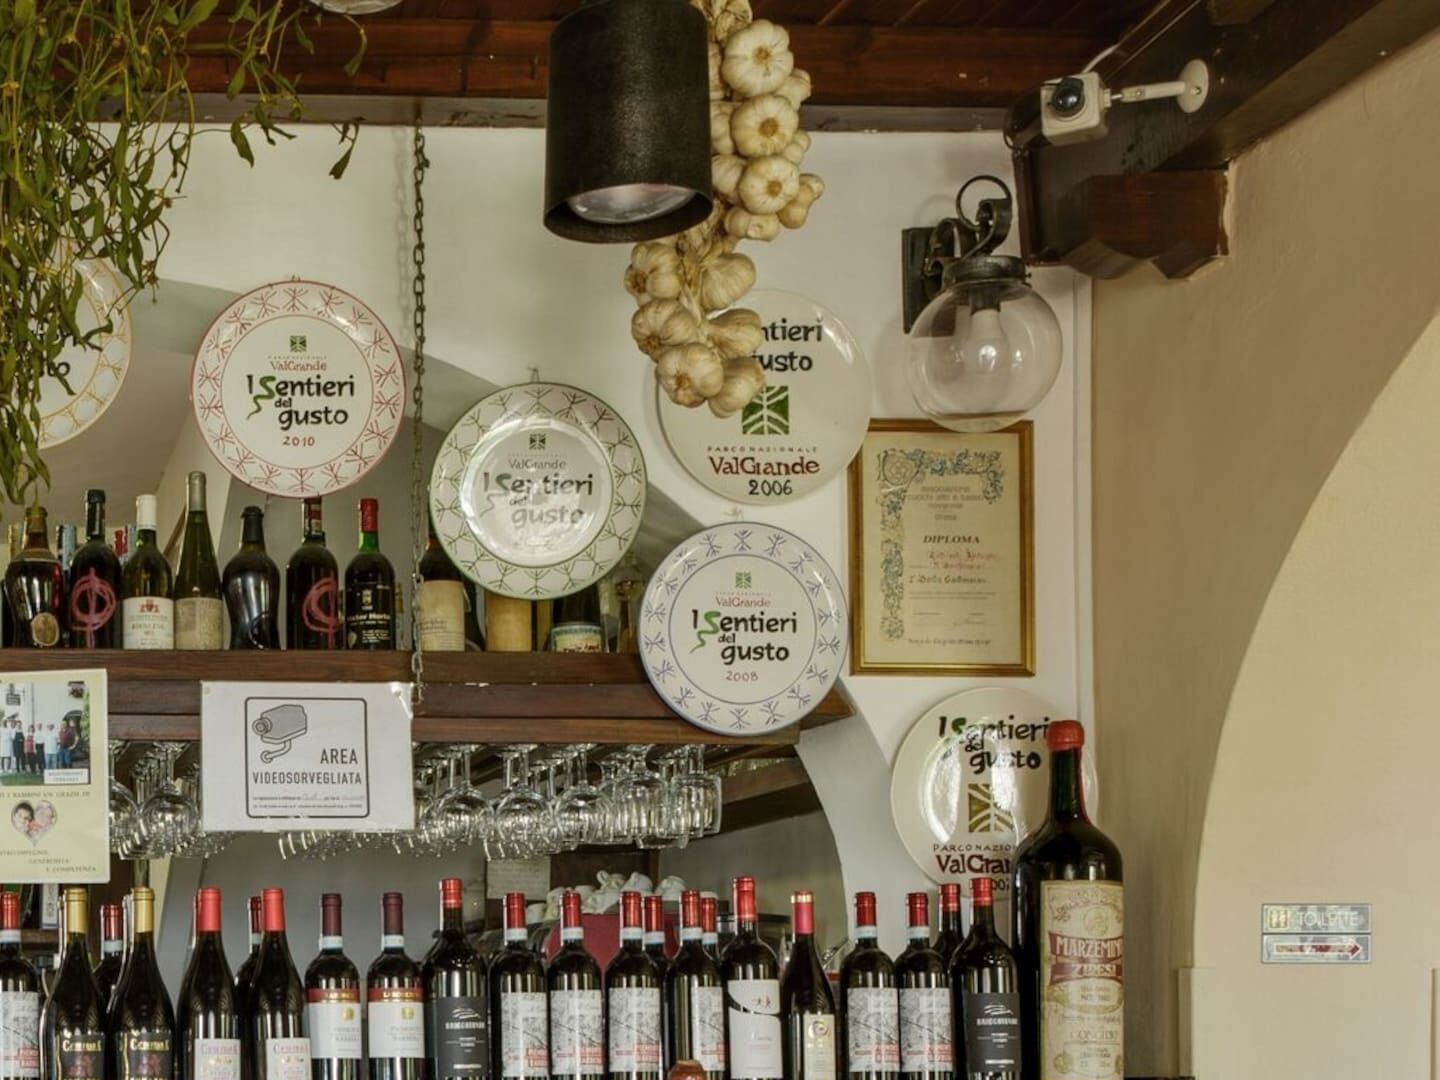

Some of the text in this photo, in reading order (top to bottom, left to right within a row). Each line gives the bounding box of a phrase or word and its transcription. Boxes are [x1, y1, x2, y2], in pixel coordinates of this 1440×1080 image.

[760, 317, 823, 343] ntieri
[269, 359, 329, 373] ValGrande
[753, 350, 814, 373] usto
[259, 373, 356, 401] Sentieri
[274, 398, 293, 409] del
[278, 406, 349, 431] gusto
[282, 435, 316, 448] 2010
[709, 456, 821, 477] ValGrande
[748, 479, 793, 496] 2006
[511, 507, 585, 530] gusto
[923, 535, 981, 545] DIPLOMA
[705, 610, 798, 635] Sentieri
[718, 632, 736, 644] del
[720, 642, 790, 666] gusto
[725, 670, 759, 682] 2008
[320, 748, 358, 765] AREA
[252, 770, 362, 785] VIDEOSORVEGLIATA
